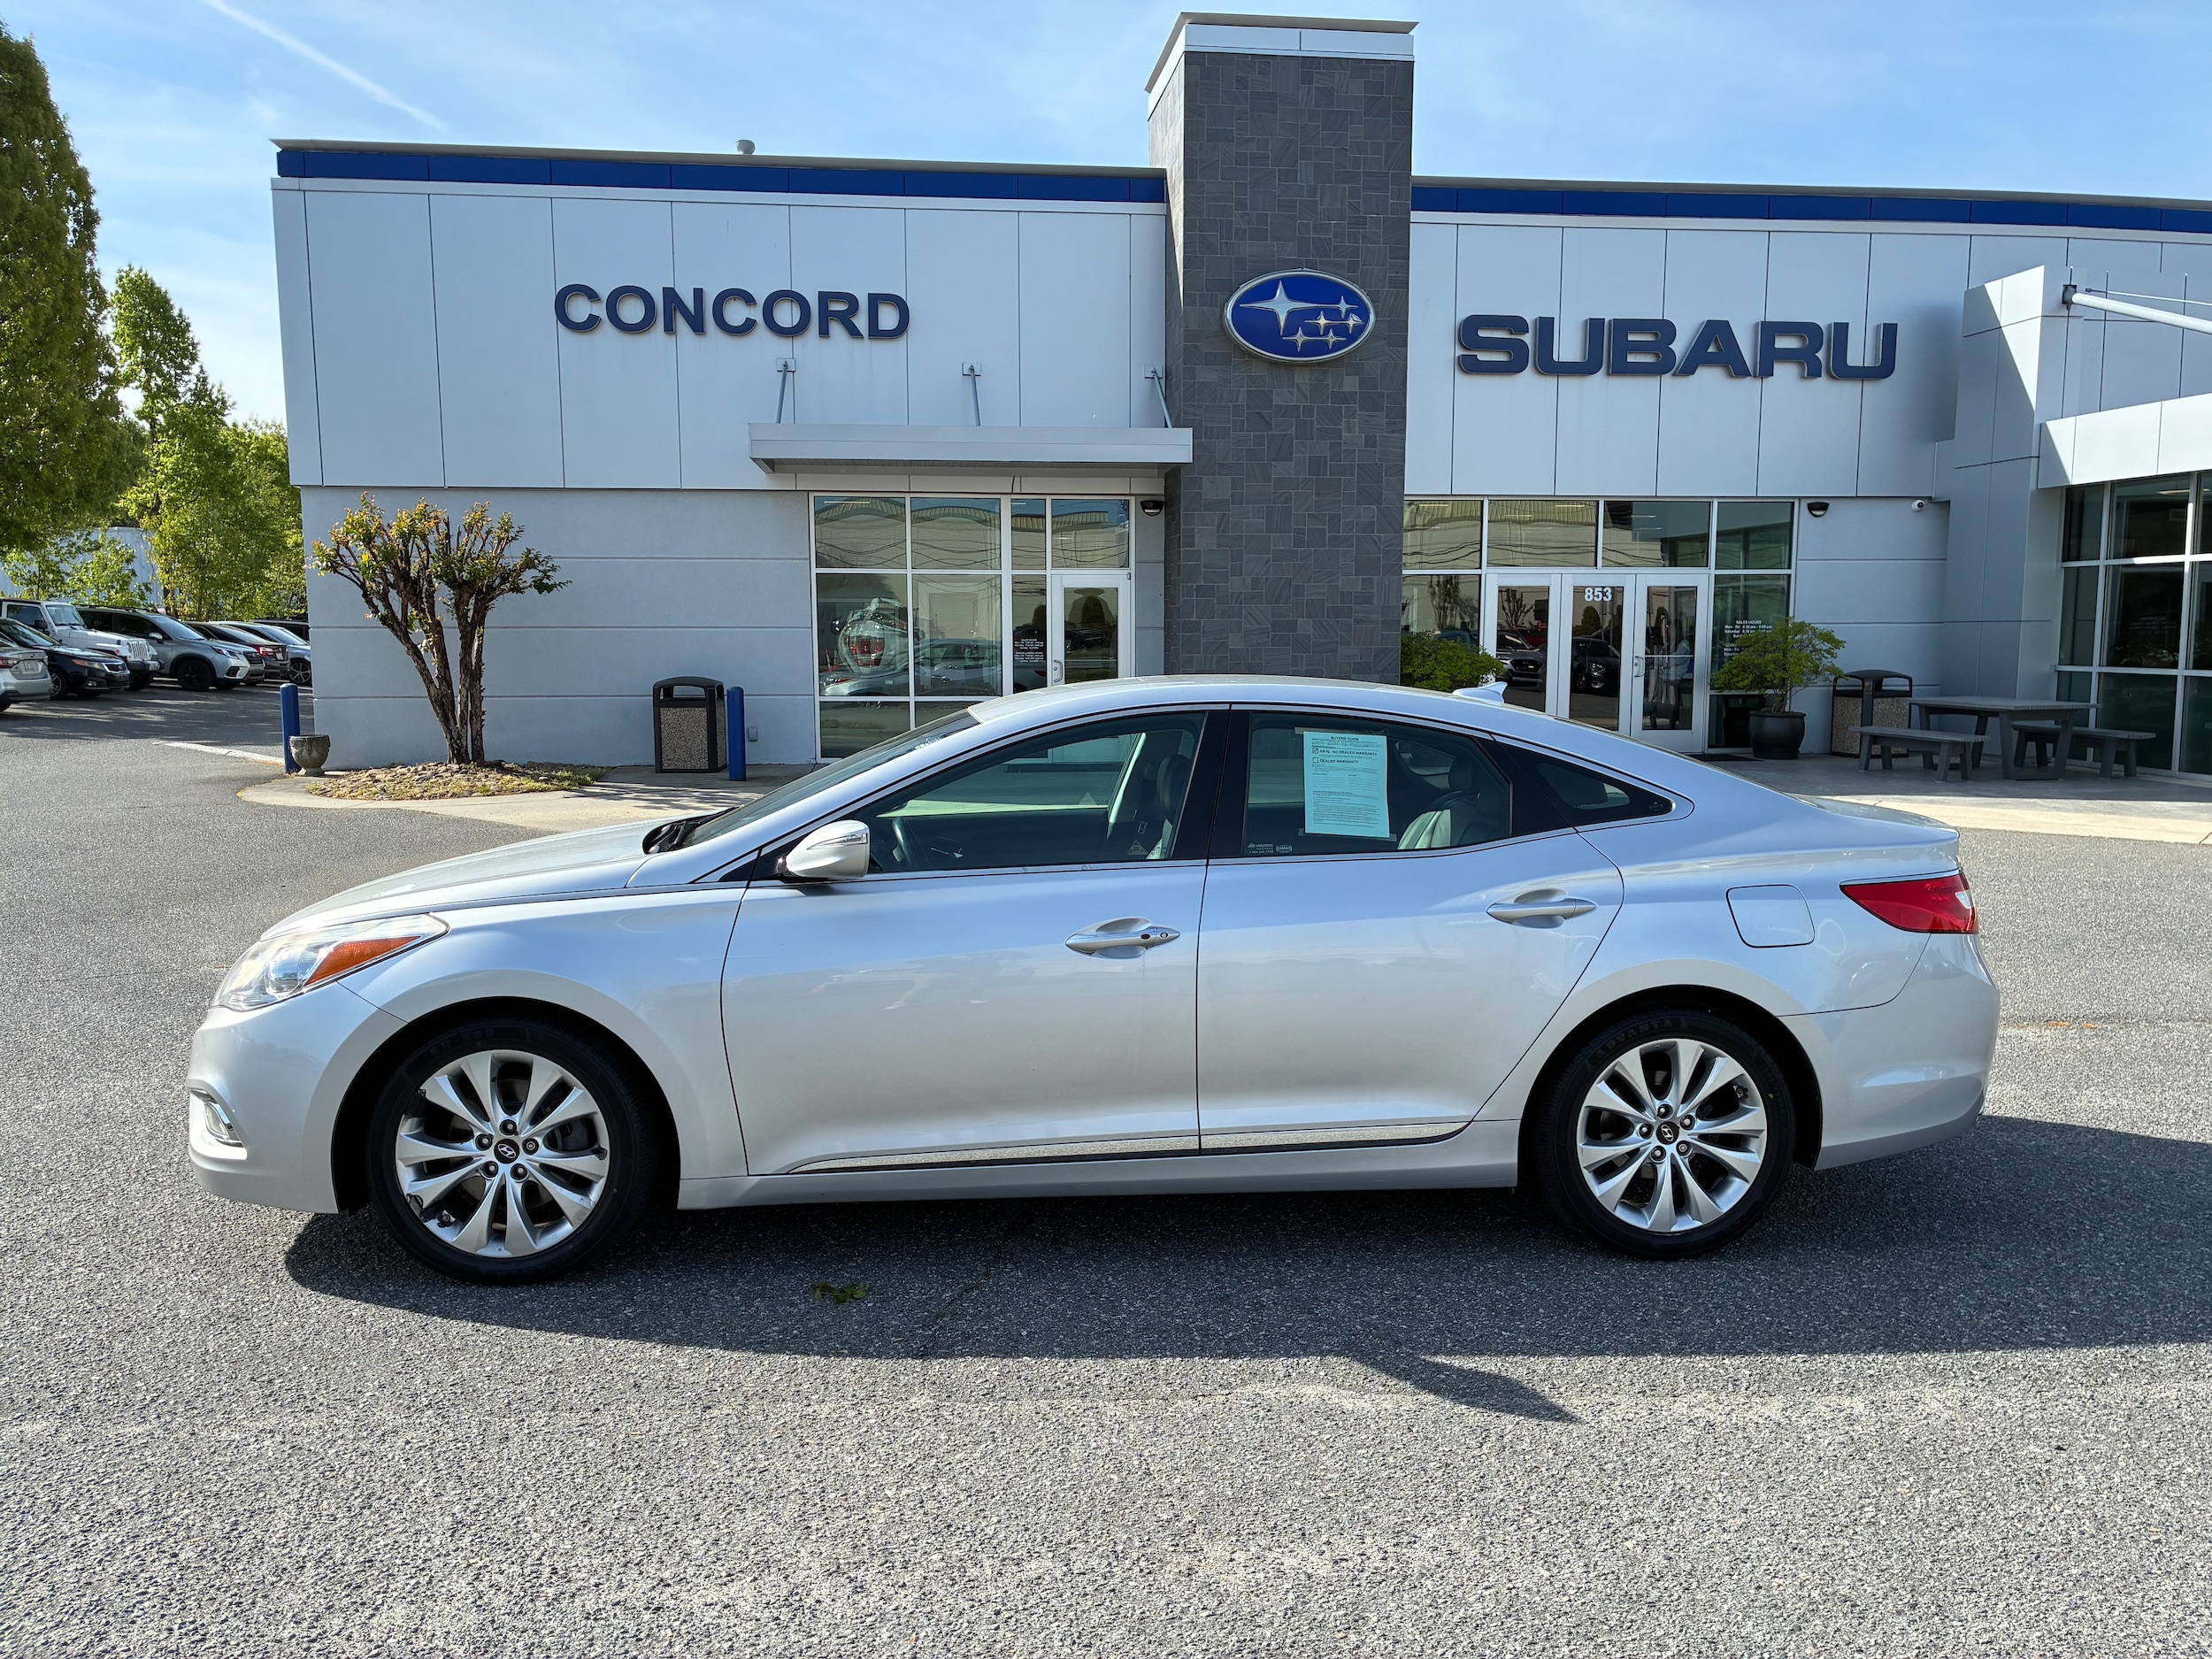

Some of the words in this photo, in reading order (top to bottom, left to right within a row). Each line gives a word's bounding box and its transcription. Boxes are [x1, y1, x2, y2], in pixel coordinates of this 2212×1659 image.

[555, 283, 910, 340] CONCORD
[1457, 314, 1898, 380] SUBARU
[1584, 587, 1612, 602] 853
[1594, 1018, 1673, 1059] ADVANTA
